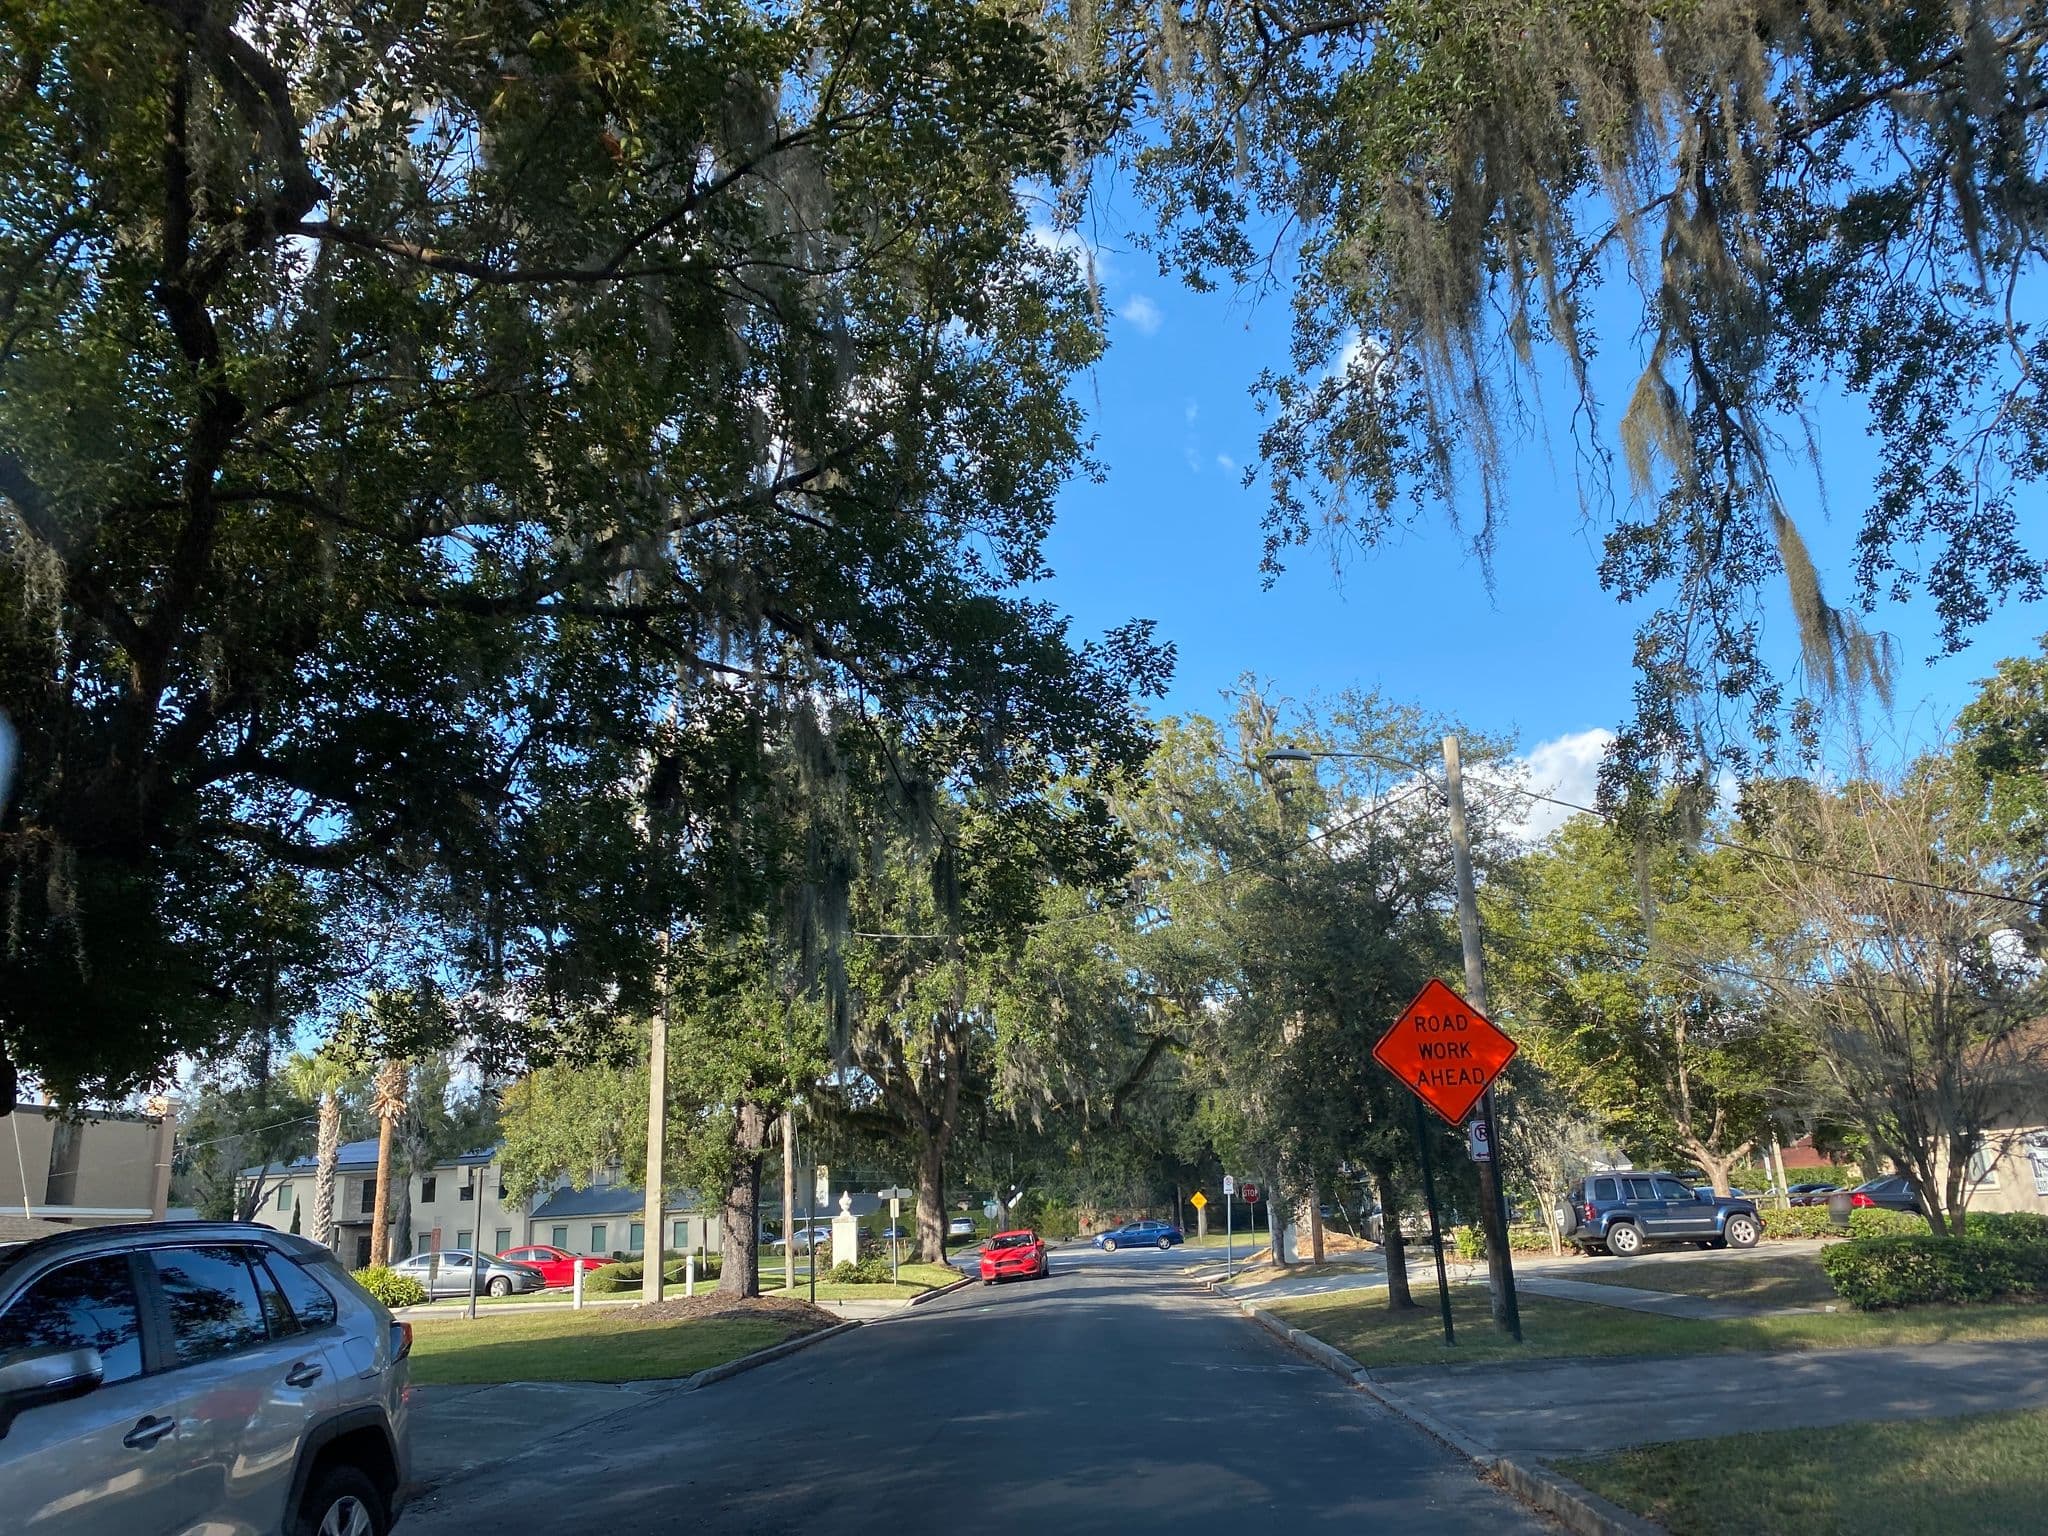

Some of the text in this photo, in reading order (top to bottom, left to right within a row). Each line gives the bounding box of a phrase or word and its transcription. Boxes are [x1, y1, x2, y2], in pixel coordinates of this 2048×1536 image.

[1414, 1014, 1468, 1032] ROAD
[1418, 1041, 1472, 1059] WORK
[1418, 1068, 1484, 1086] AHEAD
